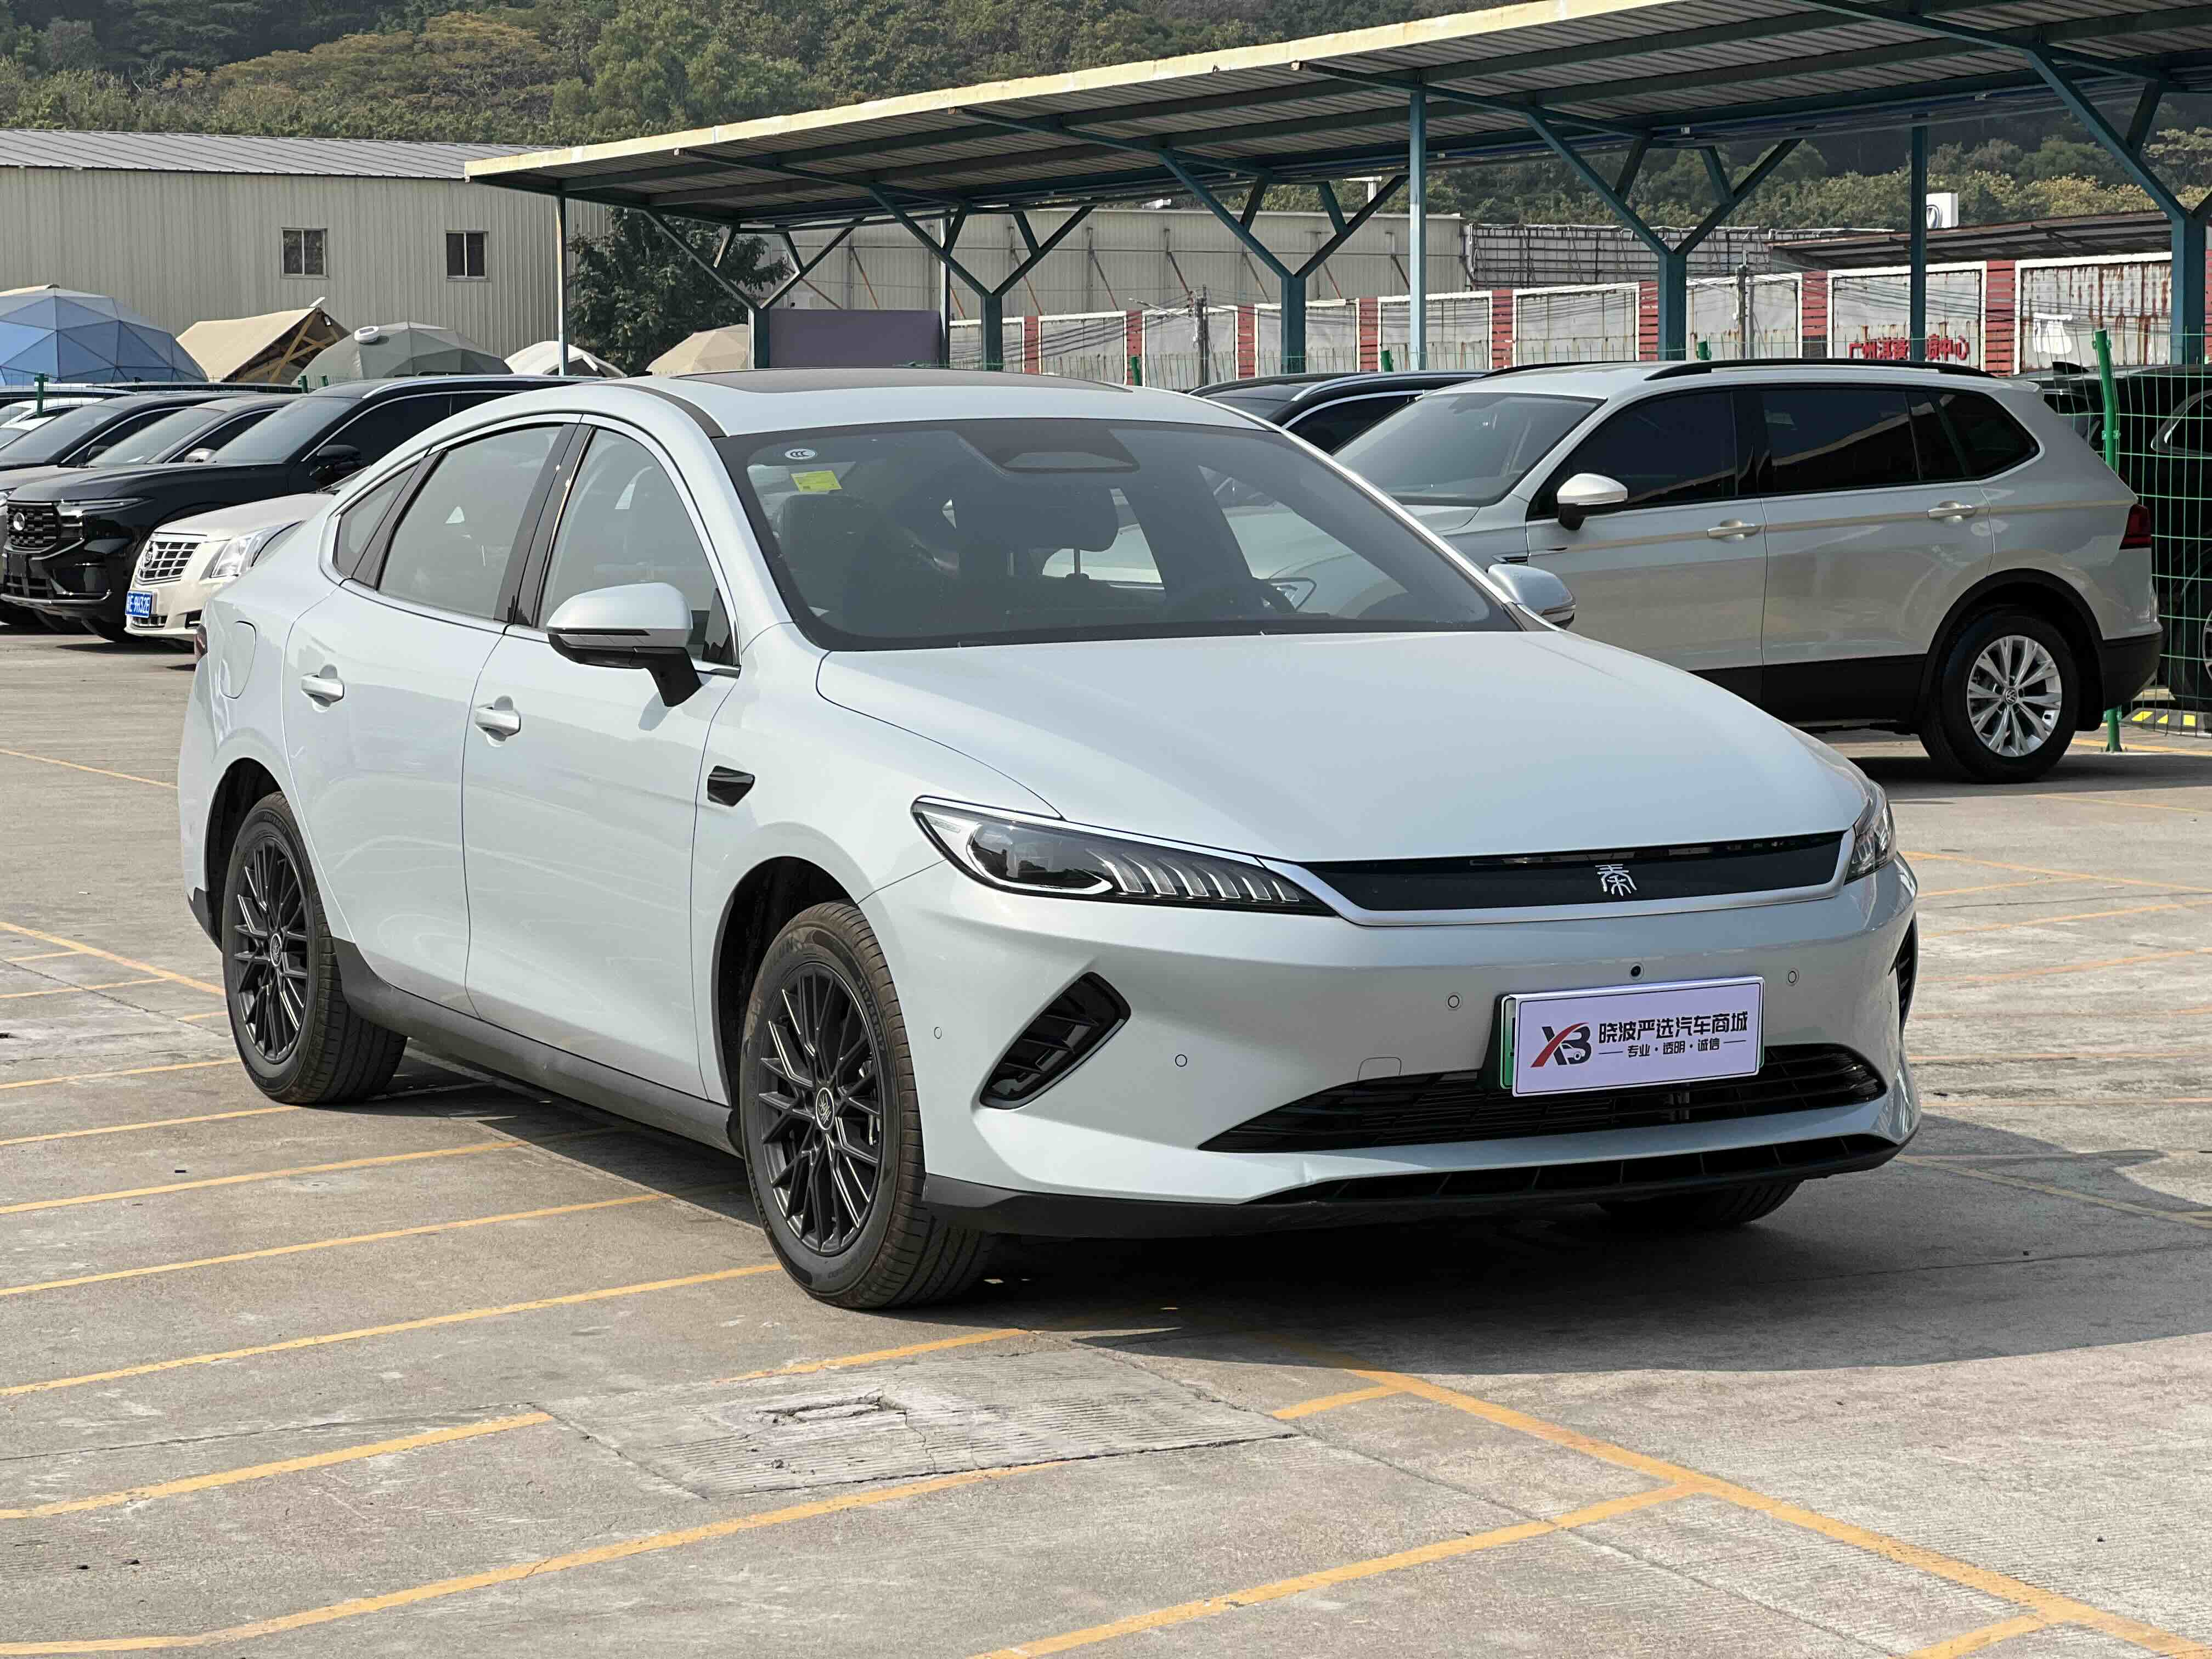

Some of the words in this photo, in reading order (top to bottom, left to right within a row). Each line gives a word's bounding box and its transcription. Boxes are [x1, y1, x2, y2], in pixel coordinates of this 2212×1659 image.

[1598, 1011, 1748, 1043] 晓波严选汽车商城
